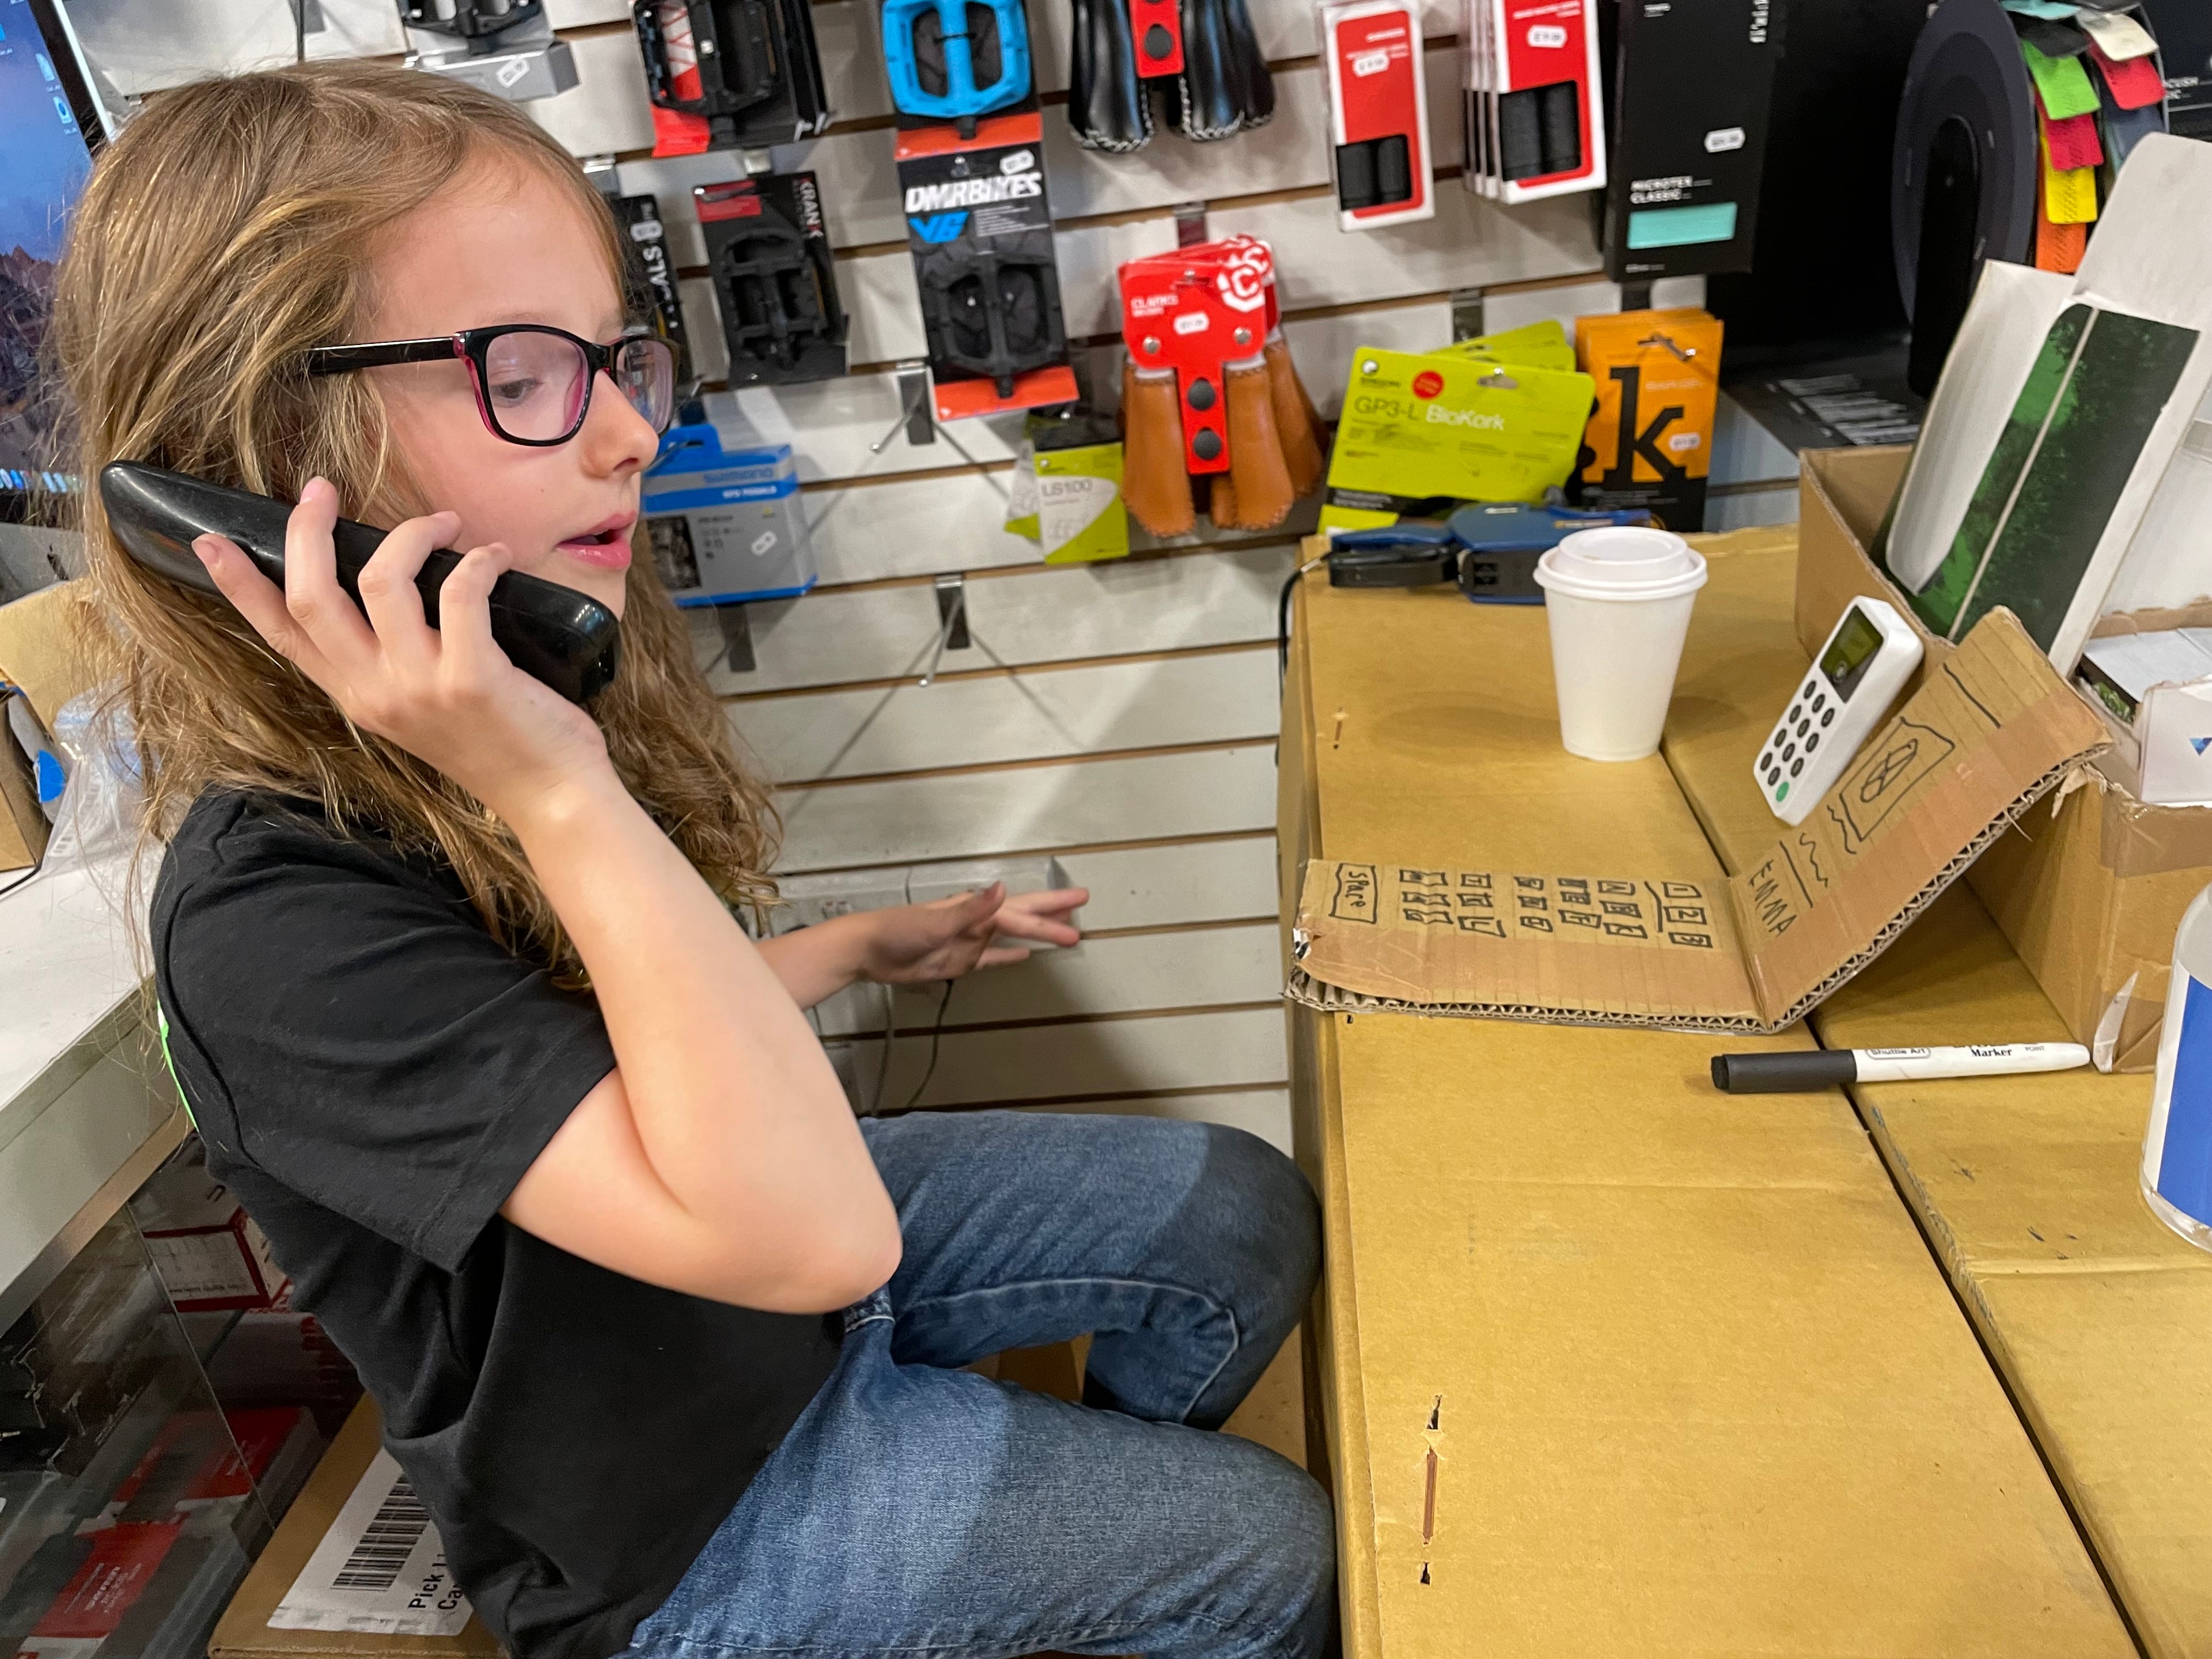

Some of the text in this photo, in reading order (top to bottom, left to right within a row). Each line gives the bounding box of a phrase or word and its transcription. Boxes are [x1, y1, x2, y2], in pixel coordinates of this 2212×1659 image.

[1354, 396, 1505, 431] GP3-L BioKork
[1746, 859, 1798, 936] EMMA
[1971, 1047, 2013, 1057] Marker
[408, 1573, 445, 1609] Pick
